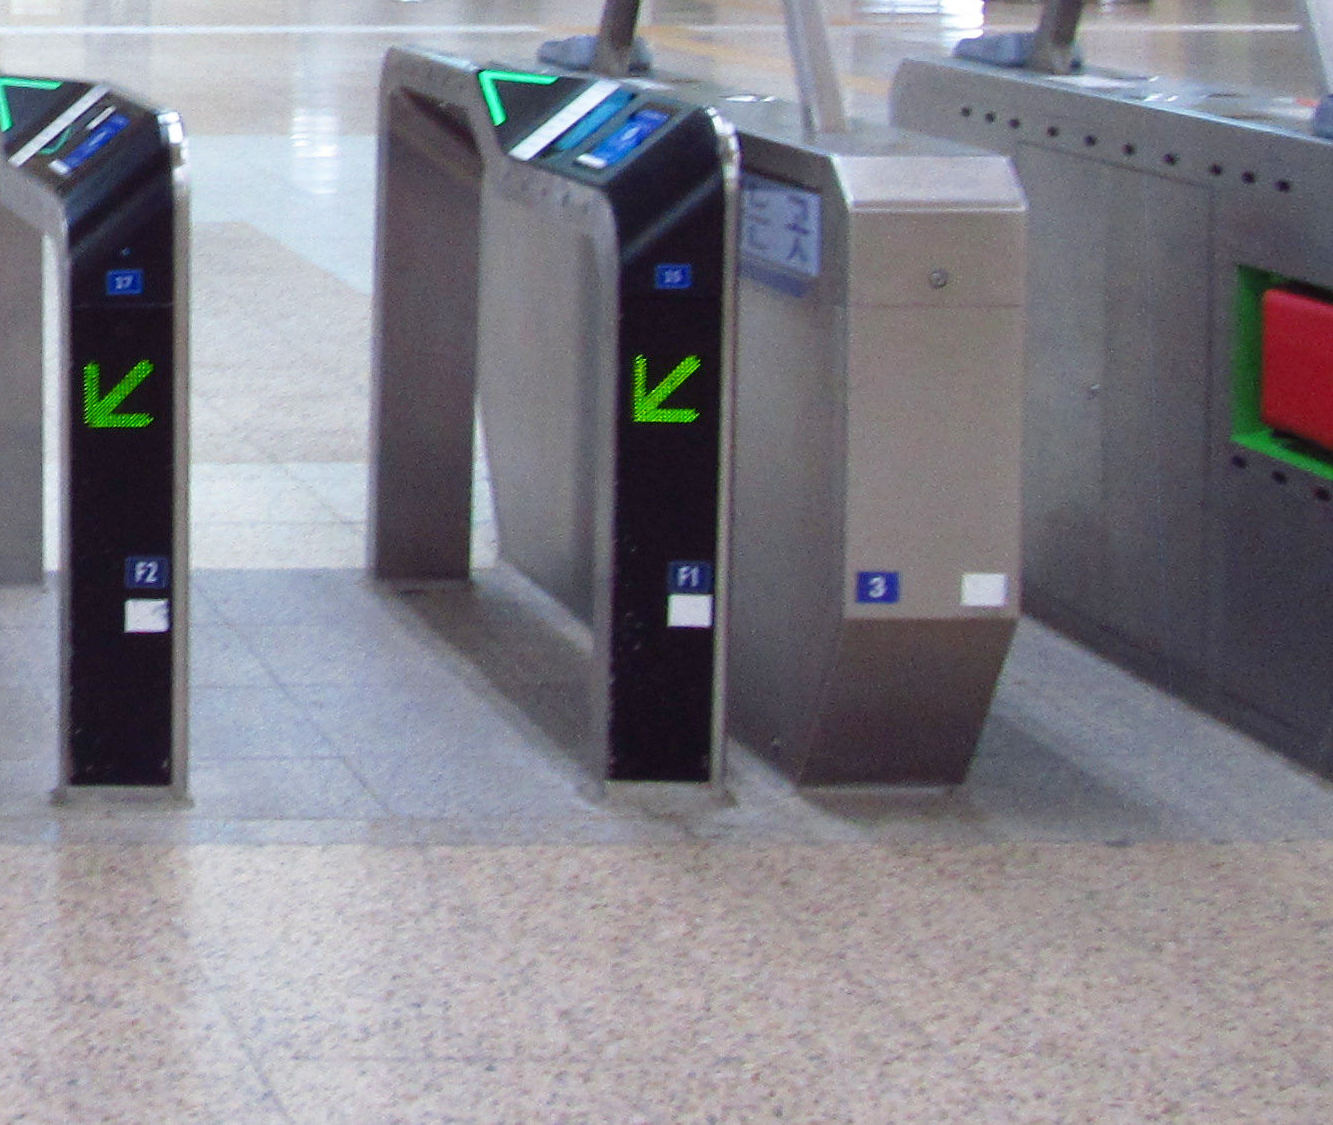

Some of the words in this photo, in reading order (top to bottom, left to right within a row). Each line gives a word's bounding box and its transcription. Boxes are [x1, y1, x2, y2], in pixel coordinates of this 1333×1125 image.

[134, 560, 159, 583] F2
[676, 565, 700, 588] F1
[867, 576, 887, 599] 3
